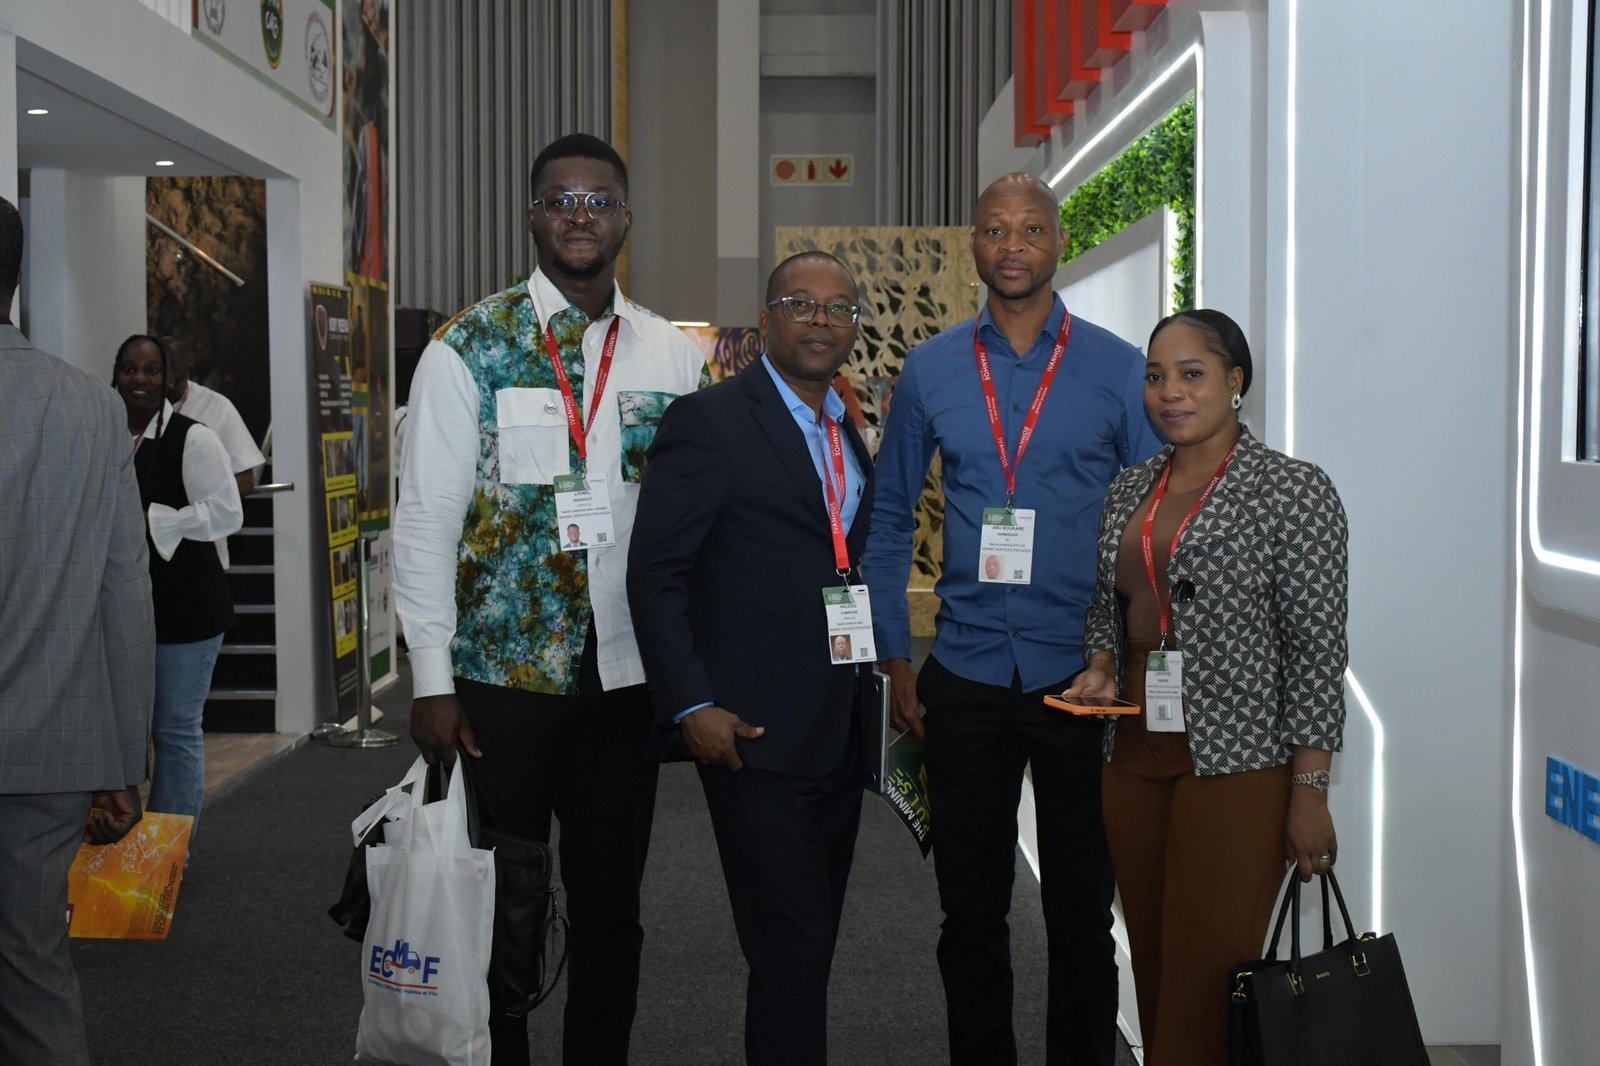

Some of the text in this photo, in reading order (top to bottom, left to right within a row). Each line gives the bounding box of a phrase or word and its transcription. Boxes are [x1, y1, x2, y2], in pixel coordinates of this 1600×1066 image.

[979, 352, 991, 381] IVANHOE
[1047, 344, 1062, 373] IVANHOE
[564, 395, 577, 426] IVANHOE
[831, 426, 841, 456] IVANHOE
[997, 436, 1008, 468] IVANHOE
[829, 503, 839, 535] IVANHOE
[912, 818, 925, 842] THE
